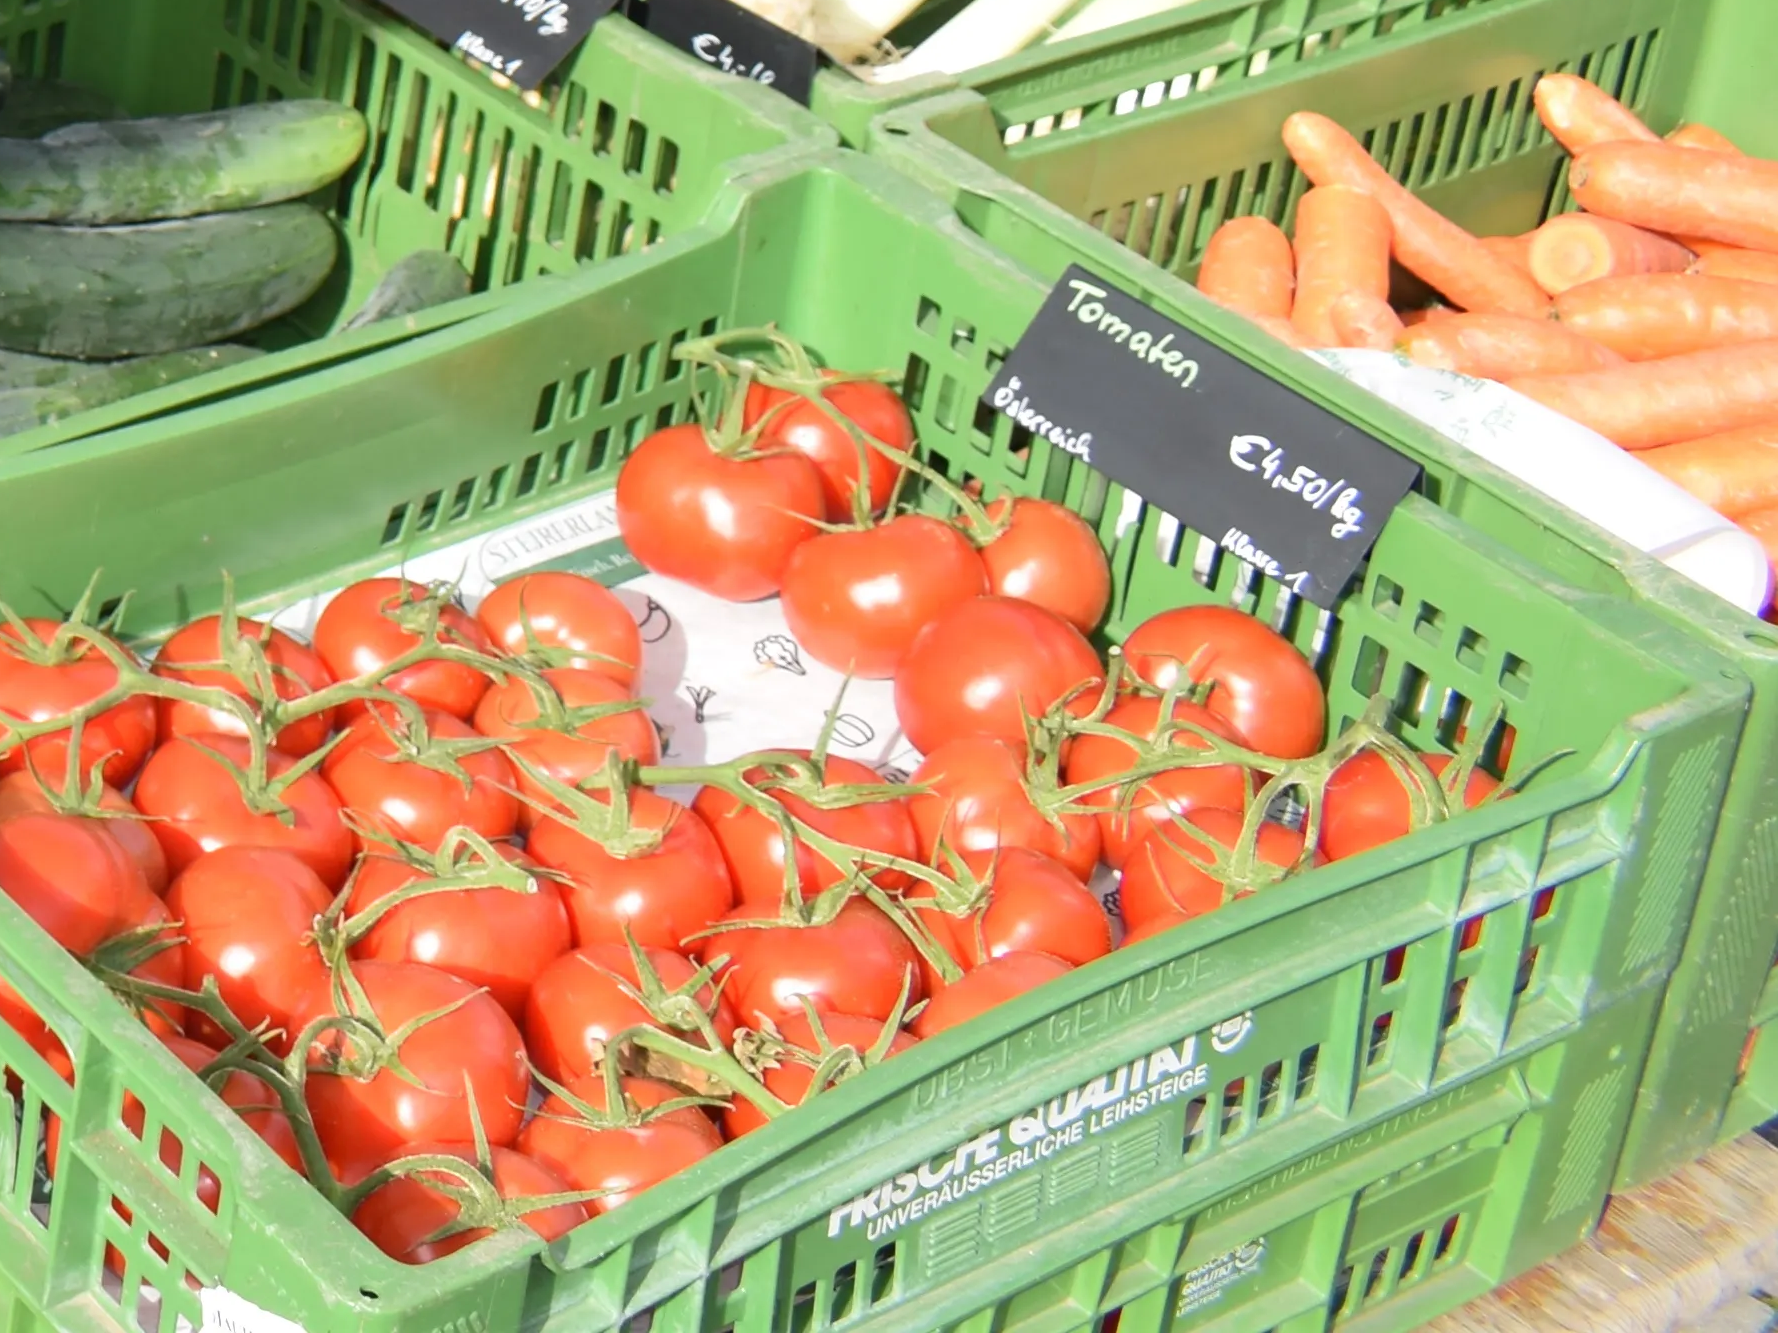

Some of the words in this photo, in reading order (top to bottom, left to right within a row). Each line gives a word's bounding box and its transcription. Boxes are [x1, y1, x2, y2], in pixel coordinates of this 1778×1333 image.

[1068, 277, 1200, 389] Tomaten
[993, 375, 1092, 464] Österreich
[1229, 433, 1364, 539] €4,50/kg
[1285, 569, 1312, 594] 1
[1088, 1063, 1209, 1133] LEIHSTEIGE
